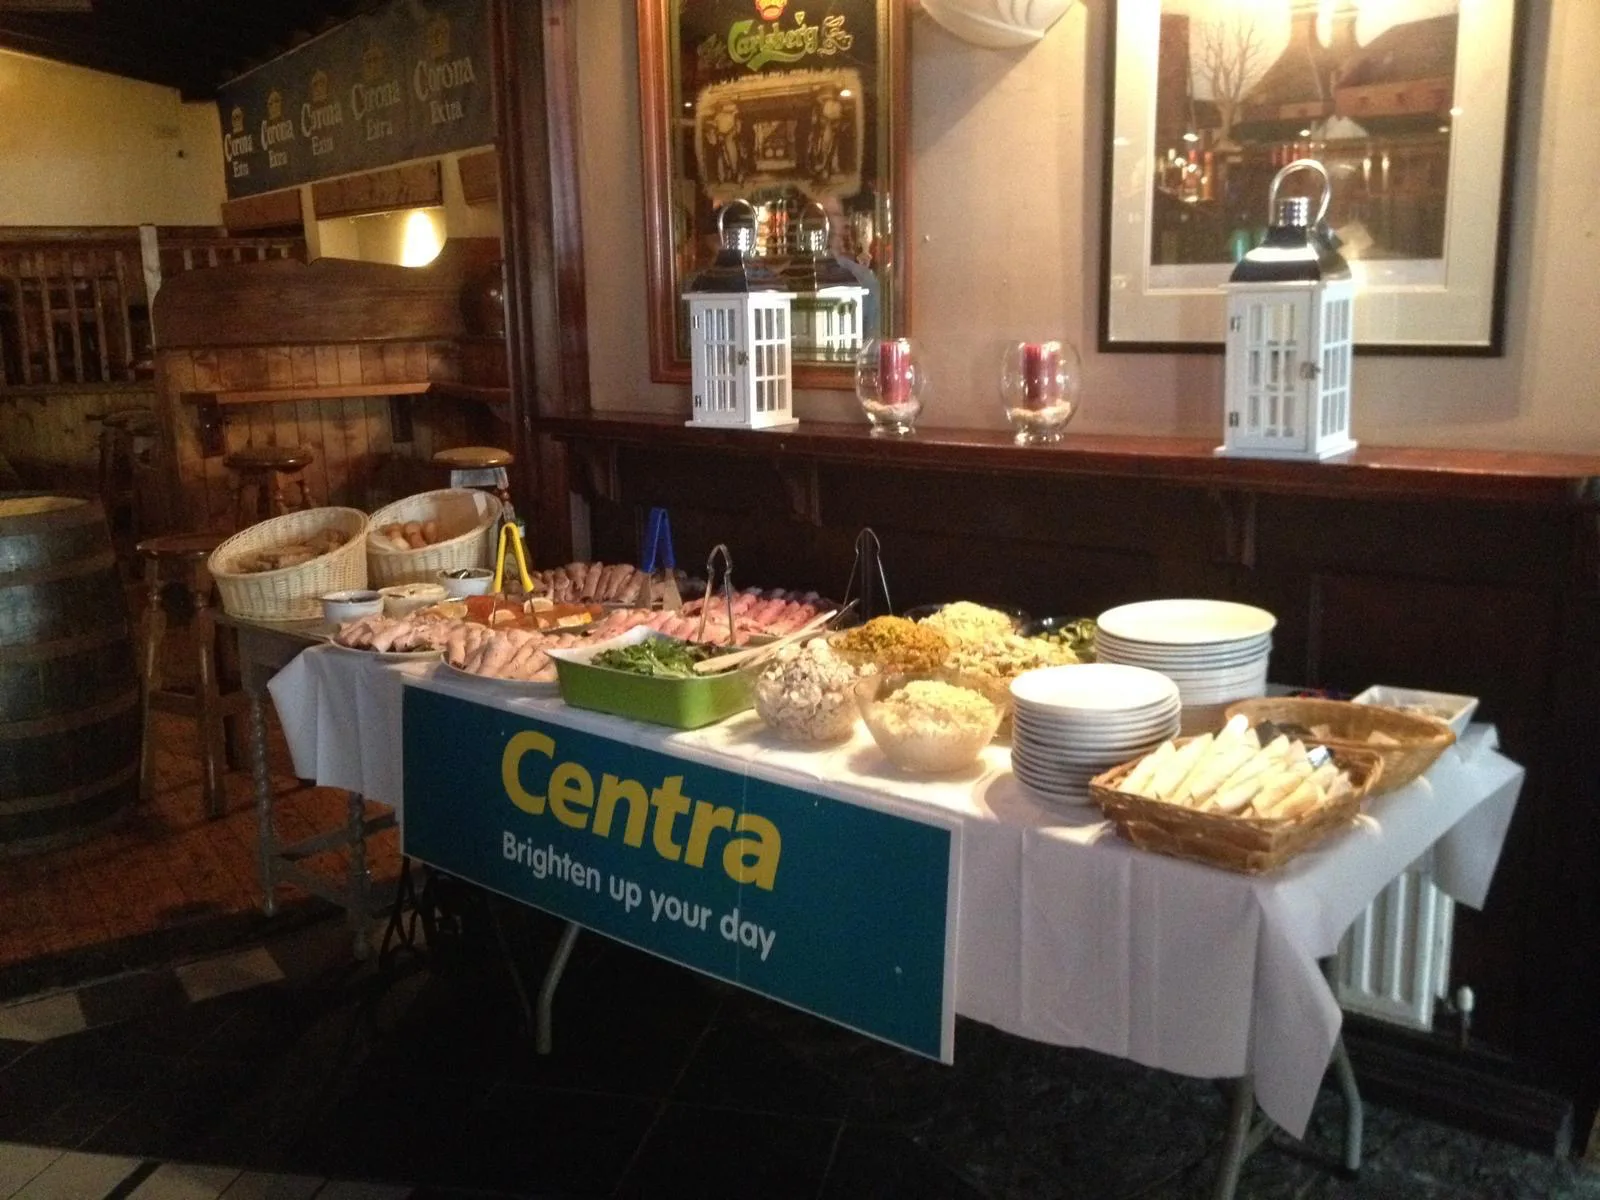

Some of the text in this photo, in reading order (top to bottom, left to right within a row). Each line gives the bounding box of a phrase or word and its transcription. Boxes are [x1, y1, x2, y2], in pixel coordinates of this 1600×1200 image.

[728, 16, 819, 71] Carlsberg
[352, 78, 401, 121] Corona
[414, 56, 476, 101] Corona
[261, 118, 295, 151] Corona
[301, 101, 342, 136] Corona
[224, 132, 253, 162] Corona
[501, 730, 782, 891] Centra
[502, 831, 776, 962] Brighten up your day
